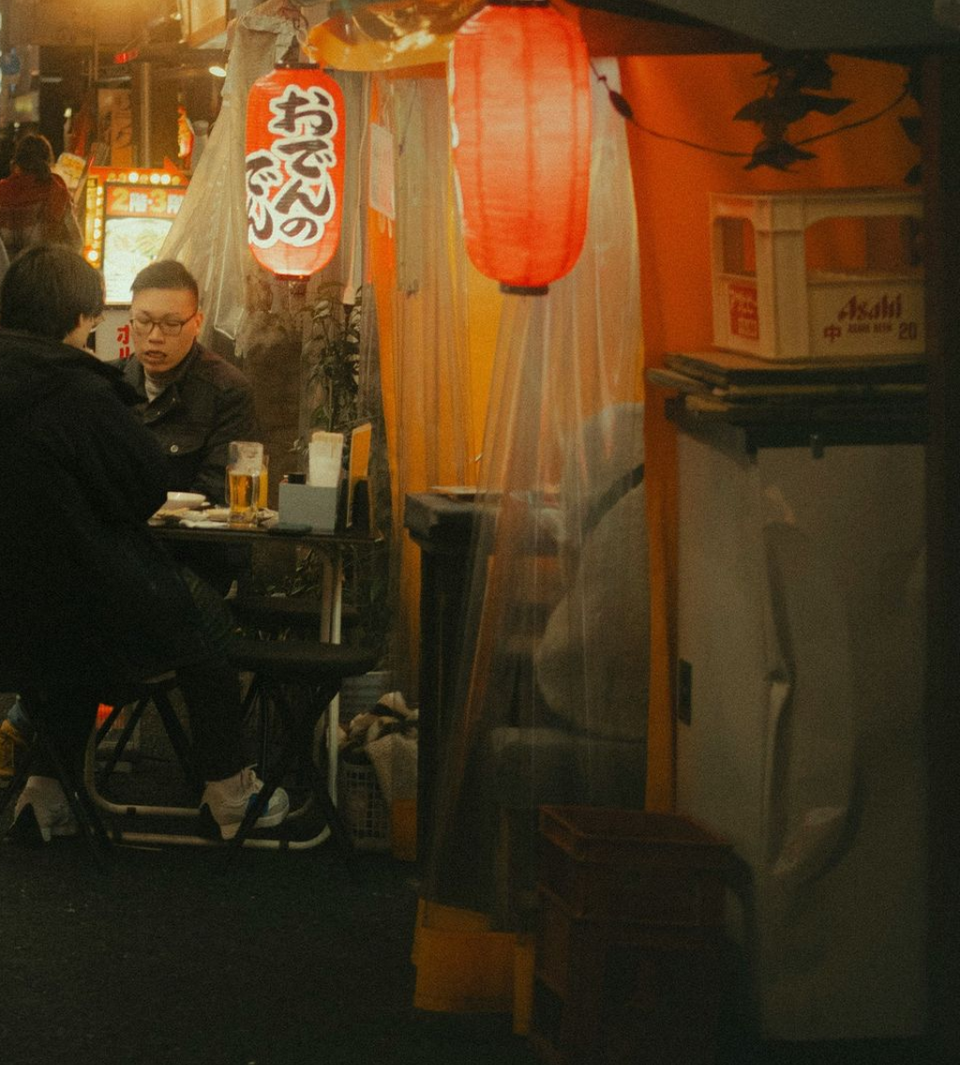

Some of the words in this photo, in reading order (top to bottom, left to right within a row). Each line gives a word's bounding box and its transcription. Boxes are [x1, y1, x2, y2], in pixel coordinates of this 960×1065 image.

[273, 89, 334, 242] おでんの
[837, 292, 903, 322] Asahi
[823, 324, 842, 344] 中
[898, 322, 918, 341] 20
